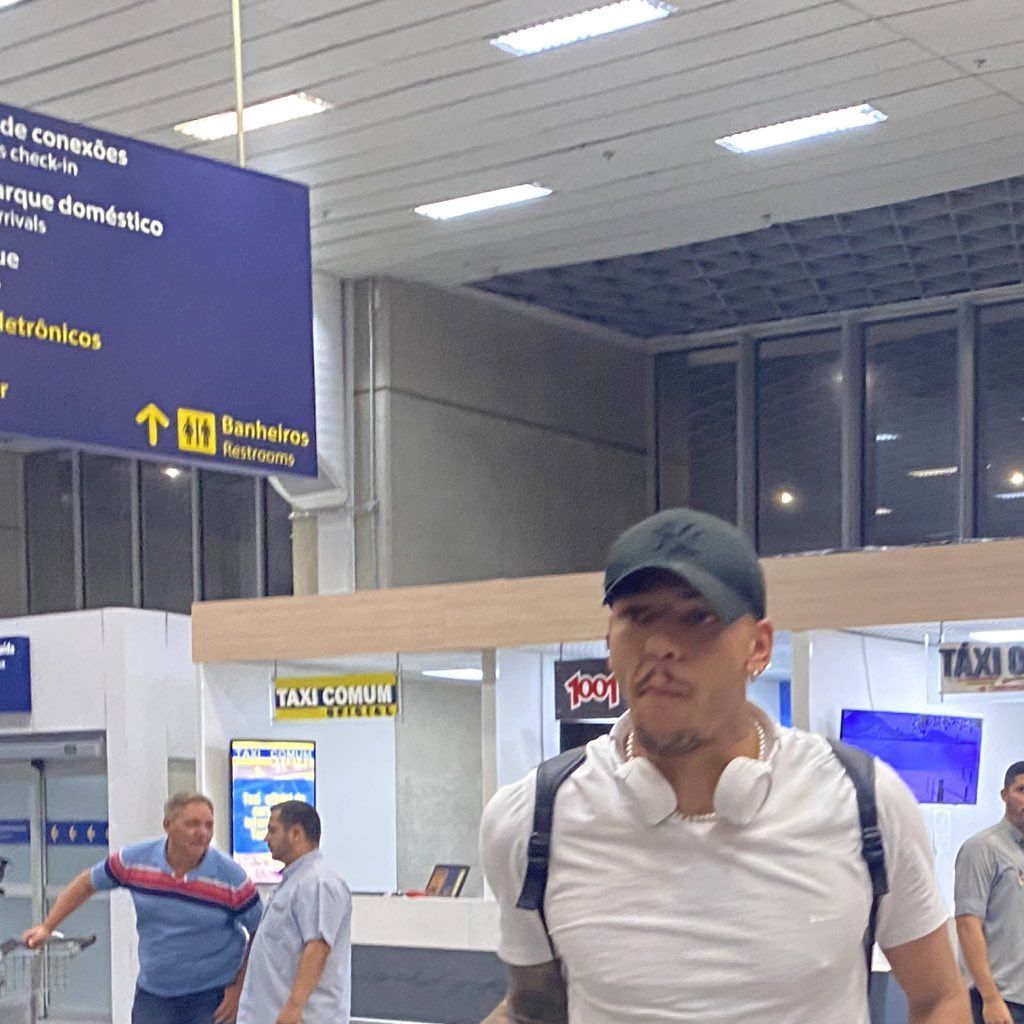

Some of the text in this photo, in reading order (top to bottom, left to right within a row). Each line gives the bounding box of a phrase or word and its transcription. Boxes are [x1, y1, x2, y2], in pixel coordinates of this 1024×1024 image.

[0, 116, 129, 167] de conexões
[10, 145, 79, 177] check-in
[58, 194, 164, 237] doméstico
[222, 414, 310, 448] Banheiros
[223, 440, 295, 468] Restrooms
[939, 641, 1002, 678] TÁXI
[276, 684, 393, 708] TAXI COMUM
[564, 669, 620, 711] 1001
